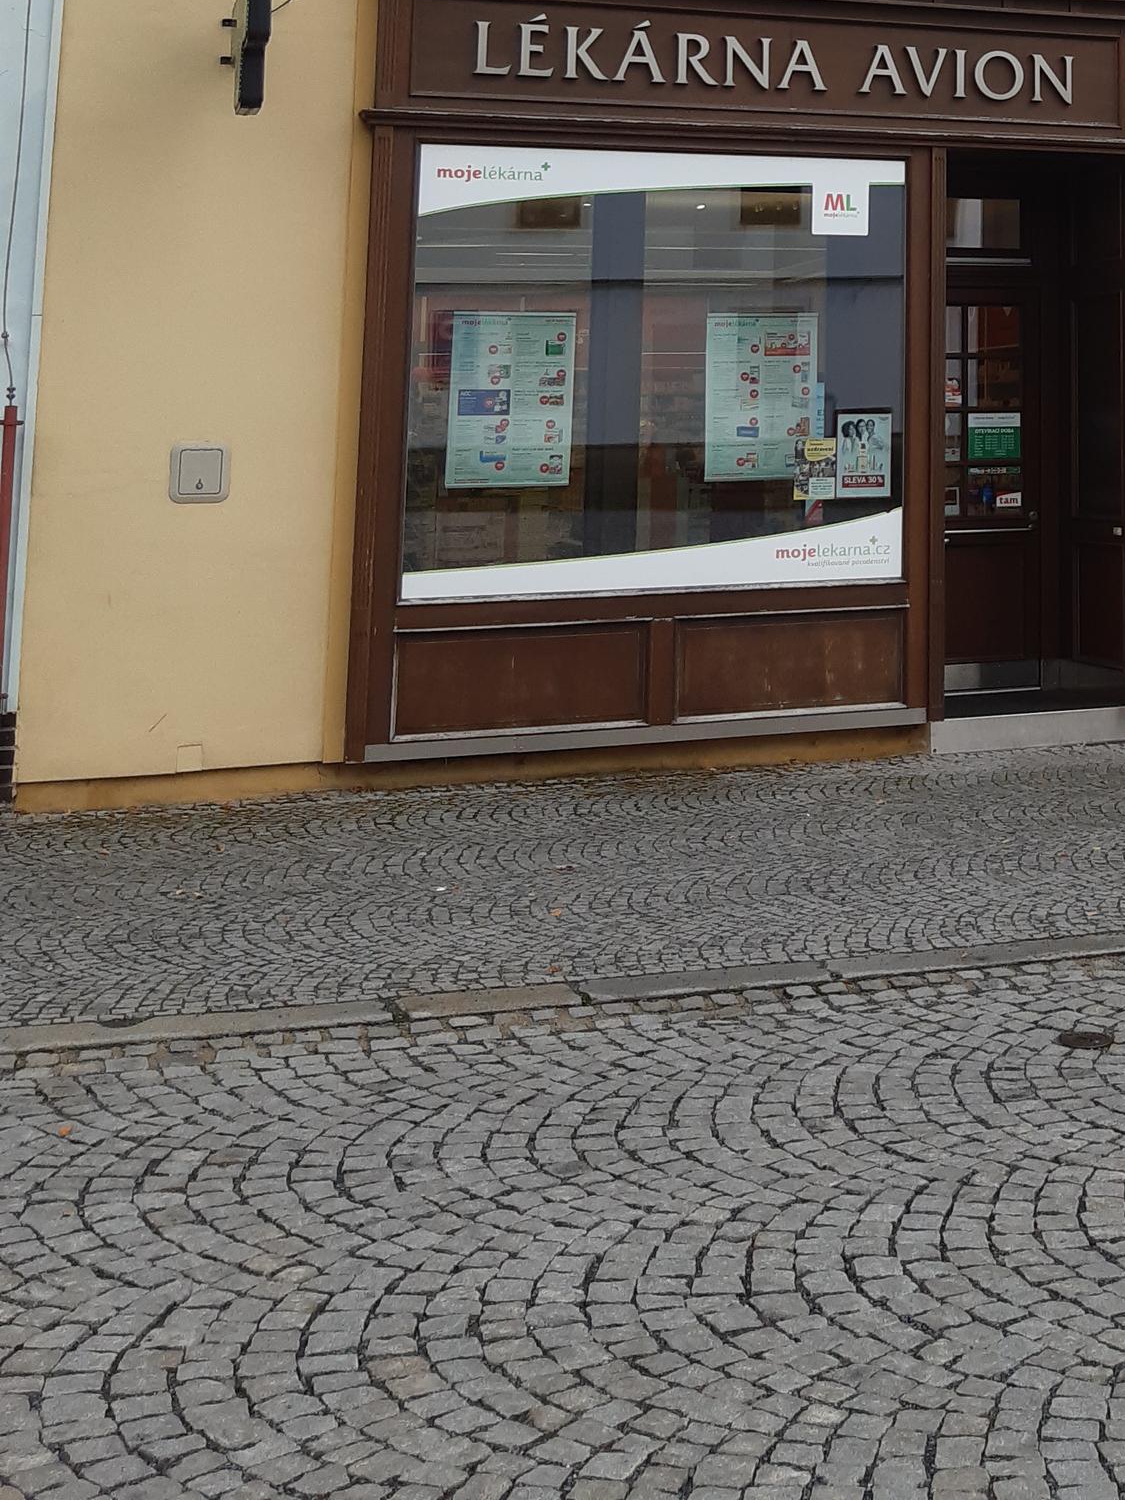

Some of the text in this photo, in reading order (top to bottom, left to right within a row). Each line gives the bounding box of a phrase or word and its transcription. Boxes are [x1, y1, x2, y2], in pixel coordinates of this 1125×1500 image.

[472, 12, 1075, 105] LÉKÁRNA AVION
[436, 164, 543, 182] mojelékárna
[824, 193, 857, 211] ML
[844, 476, 867, 484] SLEVA
[999, 496, 1019, 505] tam
[775, 543, 891, 561] mojelekarna.cz
